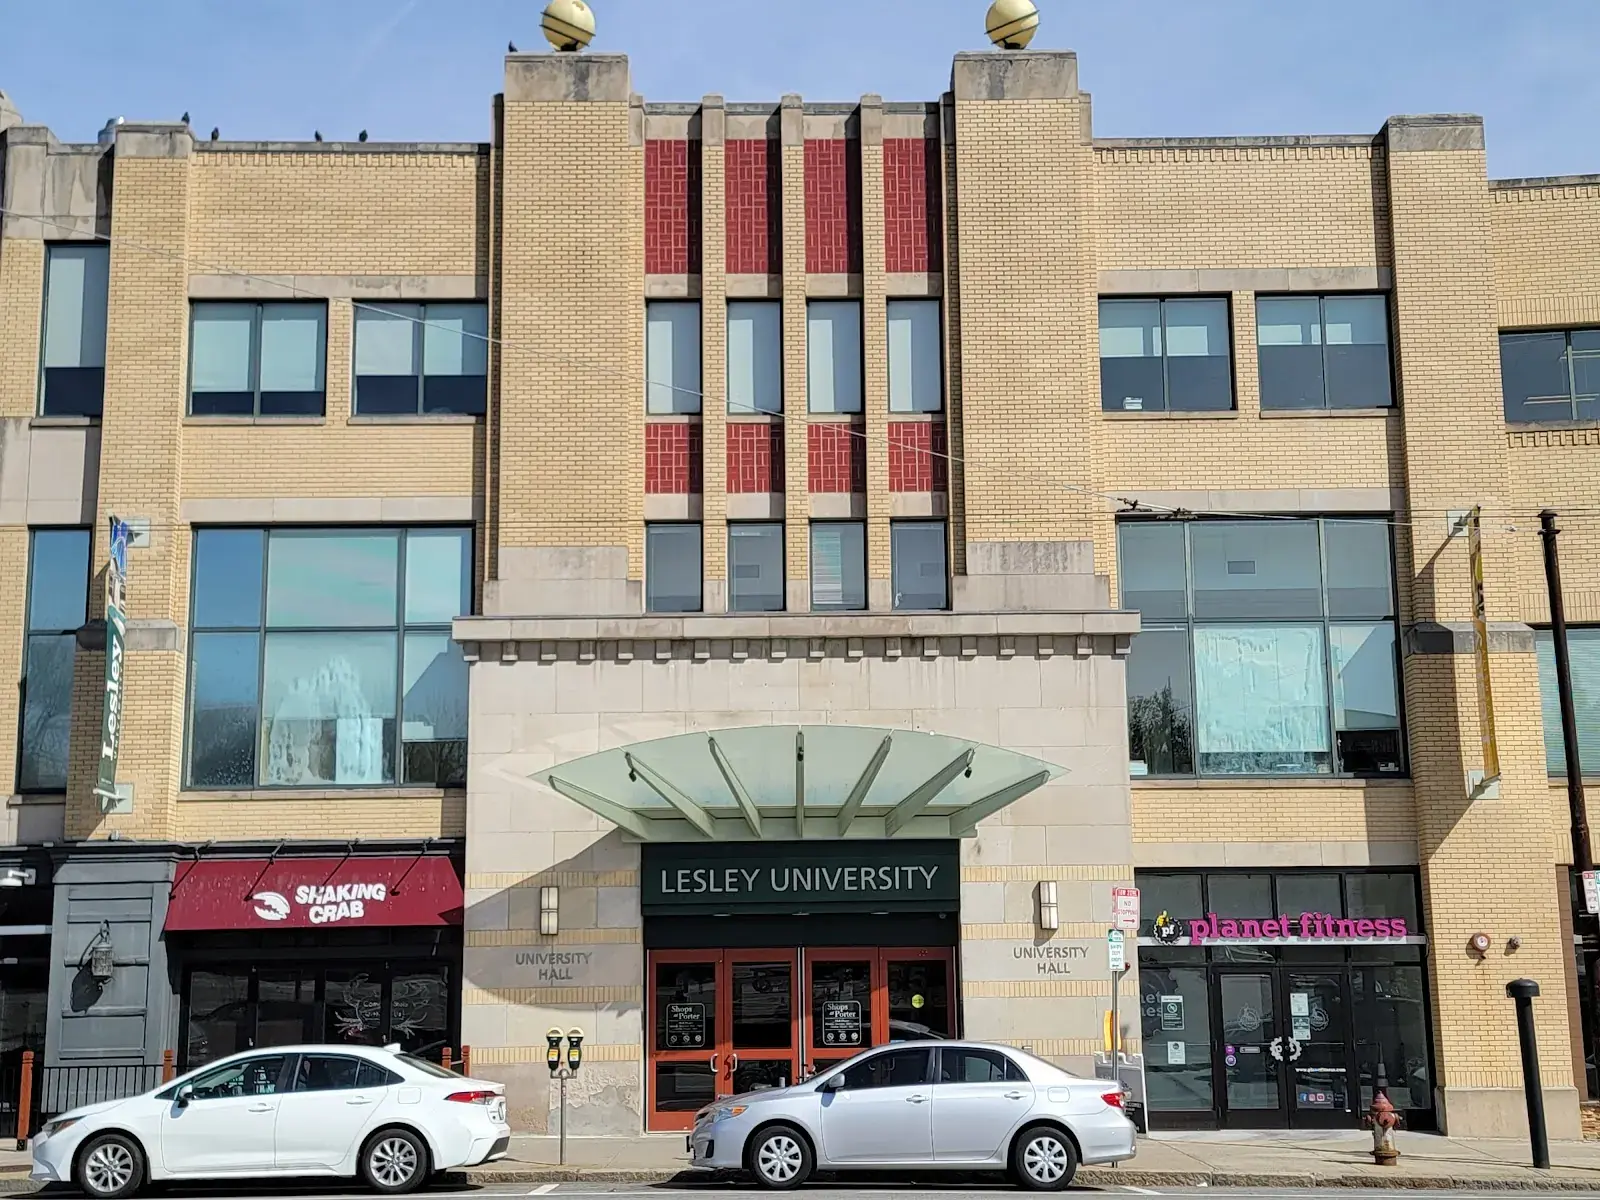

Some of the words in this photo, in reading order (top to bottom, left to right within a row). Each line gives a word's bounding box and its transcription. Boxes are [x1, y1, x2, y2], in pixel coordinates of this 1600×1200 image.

[102, 634, 122, 761] Lesley
[661, 868, 760, 893] LESLEY
[770, 866, 938, 892] UNIVERSITY
[295, 883, 386, 904] SHAKING
[309, 900, 364, 924] CRAB
[1161, 925, 1175, 938] pf
[1189, 912, 1292, 944] planet
[1300, 912, 1407, 938] fitness
[515, 952, 593, 965] UNIVERSITY
[1013, 946, 1089, 959] UNIVERSITY
[538, 968, 573, 980] HALL
[1037, 962, 1071, 974] HALL
[671, 1005, 692, 1014] Shops
[827, 1003, 848, 1012] Shops
